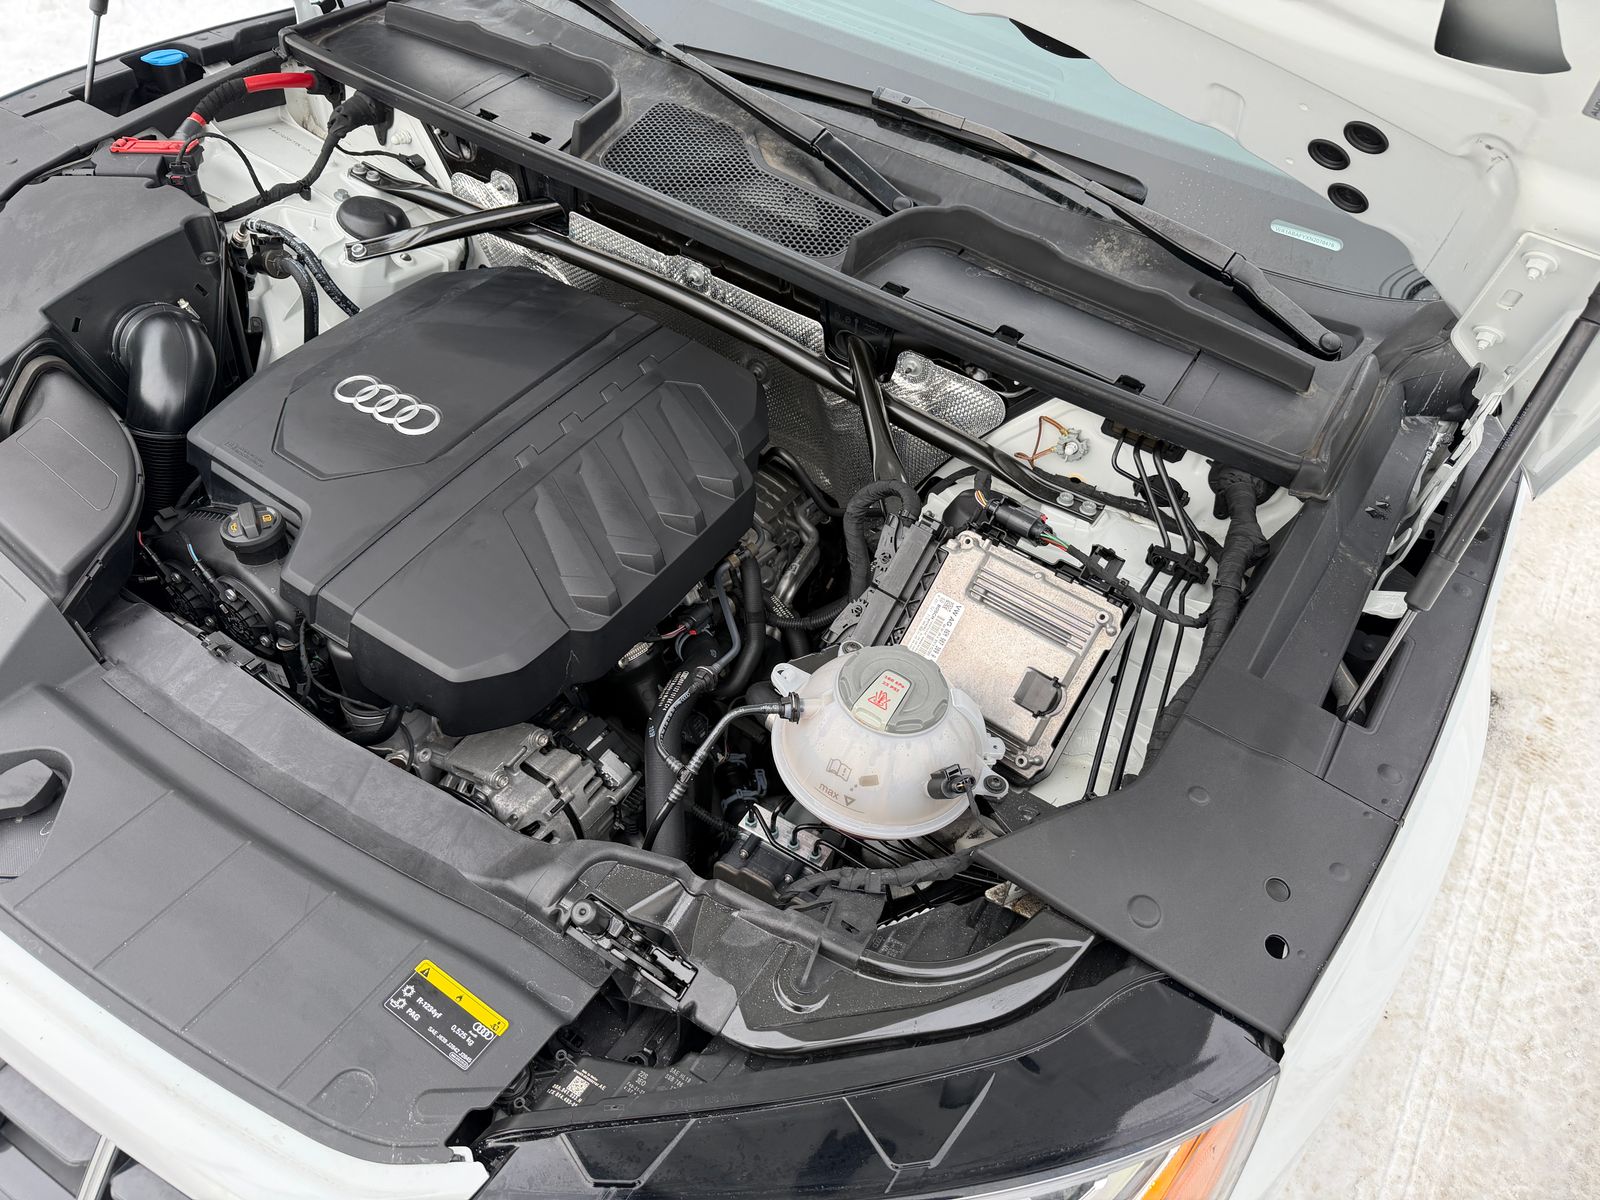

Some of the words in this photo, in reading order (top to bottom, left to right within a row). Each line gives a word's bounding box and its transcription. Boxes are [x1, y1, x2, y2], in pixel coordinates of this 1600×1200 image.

[952, 605, 962, 617] VW
[946, 616, 955, 627] AG
[819, 783, 839, 800] max
[416, 996, 443, 1019] R-1234yf
[405, 1007, 421, 1022] PAG
[427, 1026, 438, 1036] SAE
[450, 1024, 468, 1040] 0,525
[465, 1036, 475, 1047] kg
[669, 1067, 680, 1077] SAE
